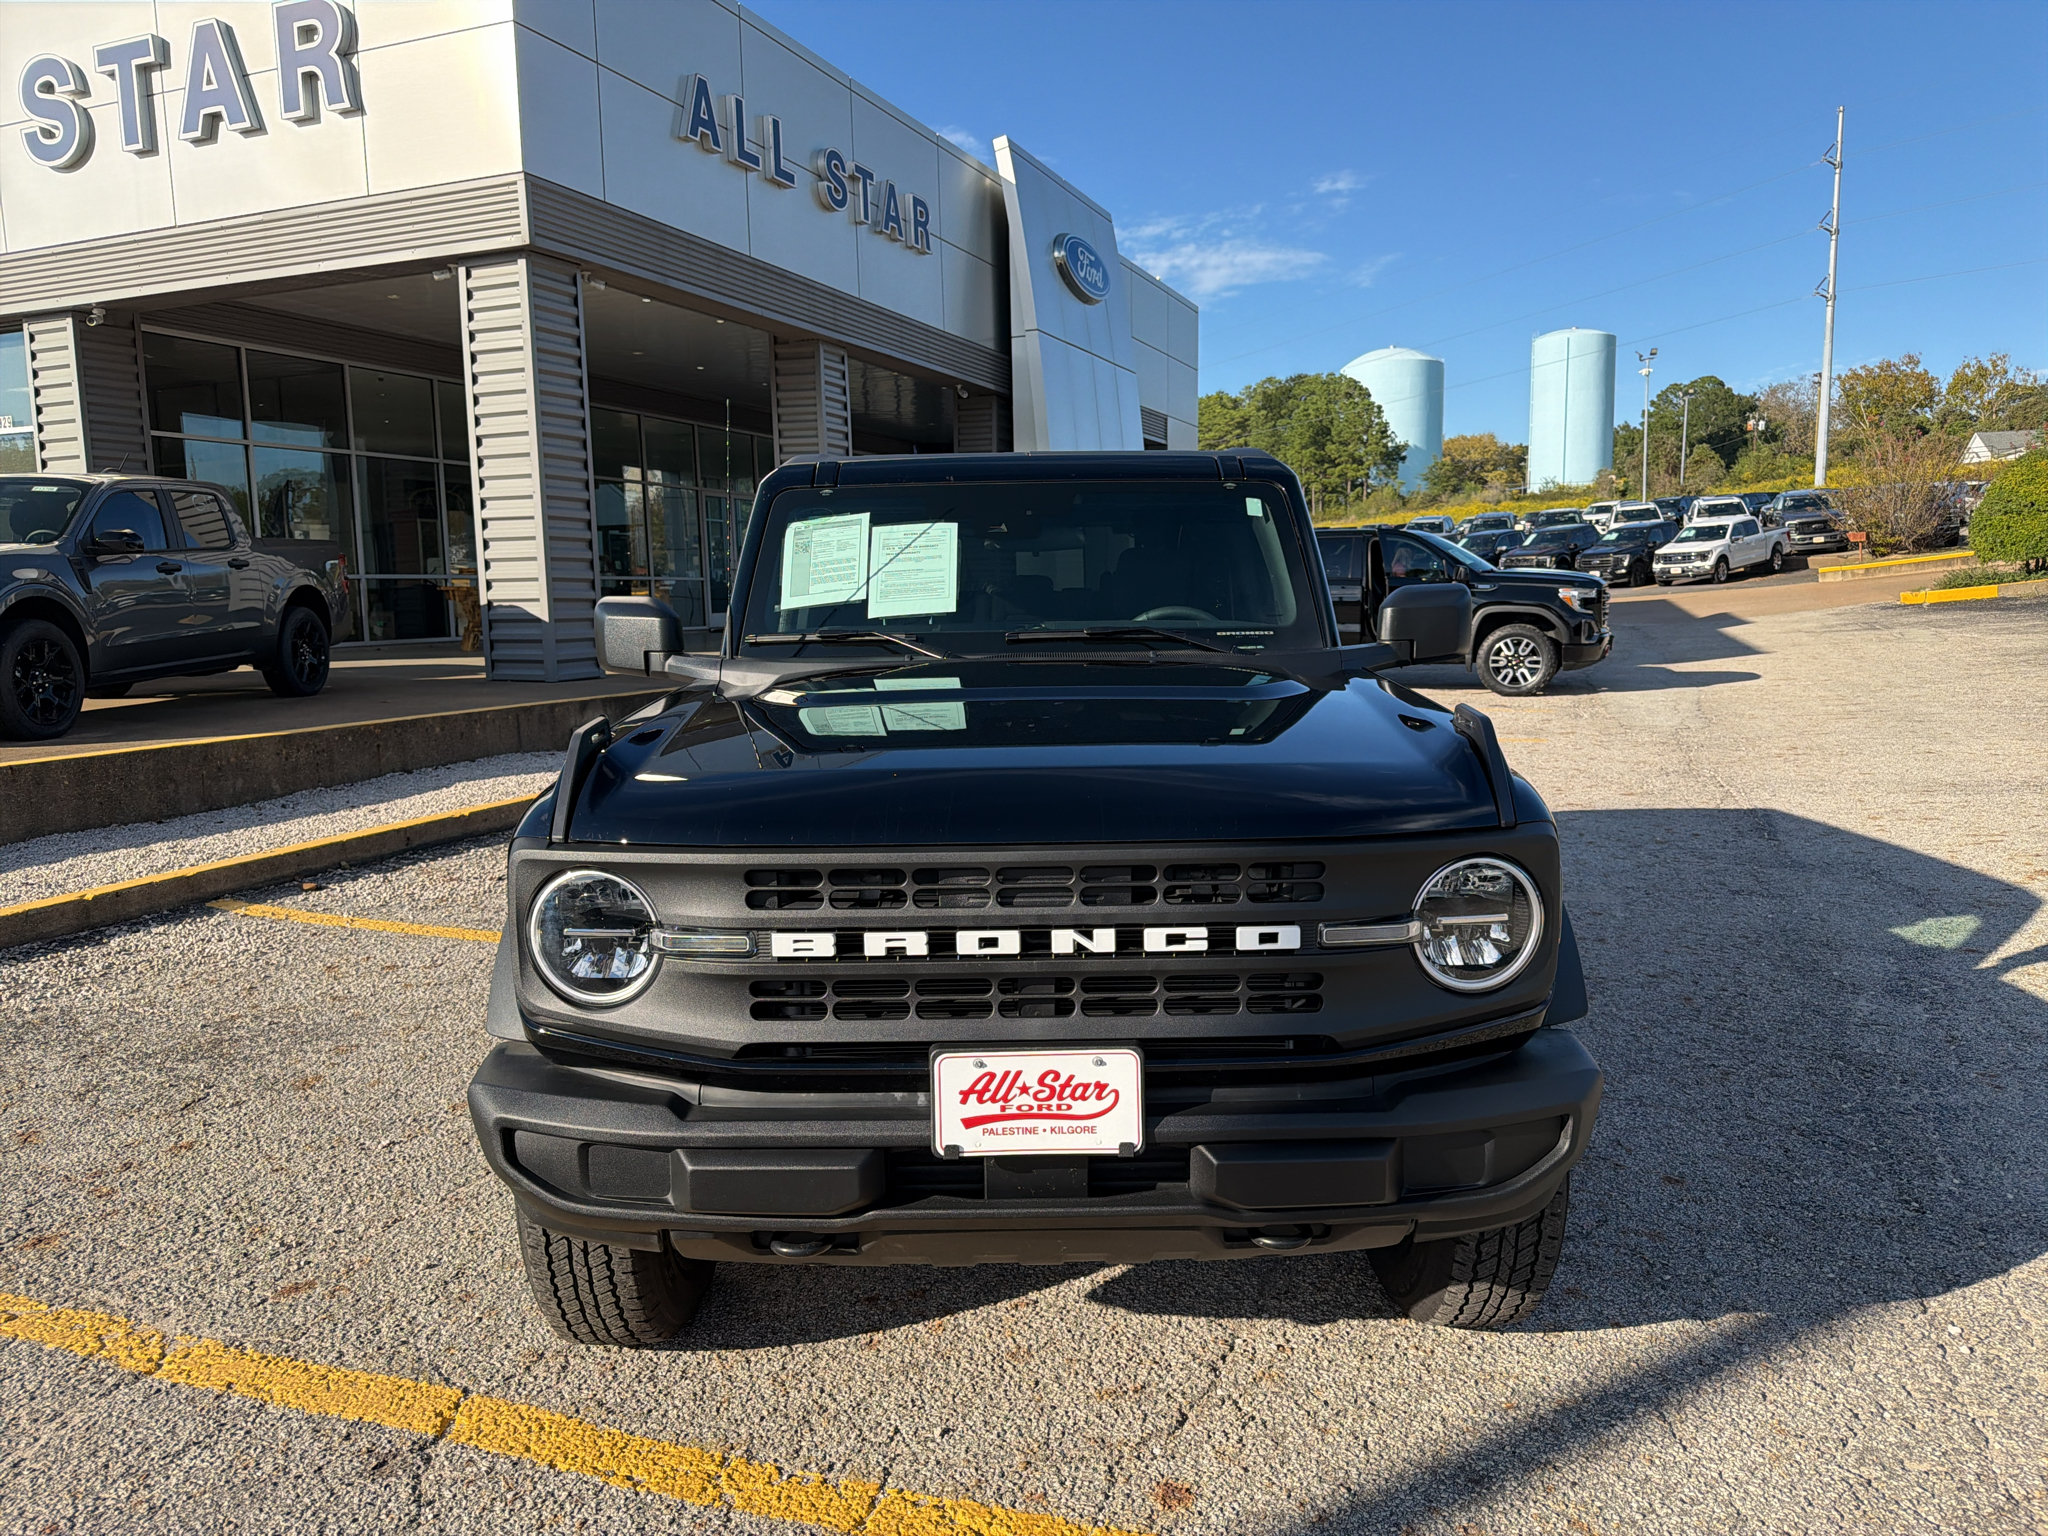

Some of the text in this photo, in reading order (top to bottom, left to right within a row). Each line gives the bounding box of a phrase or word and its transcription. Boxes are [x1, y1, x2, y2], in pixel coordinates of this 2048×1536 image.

[18, 0, 360, 168] STAR
[680, 73, 931, 254] ALL STAR
[1077, 247, 1104, 289] Ford
[771, 925, 1301, 957] BRONCO
[958, 1069, 1112, 1105] All Star
[1000, 1103, 1073, 1112] FORD
[982, 1125, 1098, 1137] PALESTINE KILGORE
